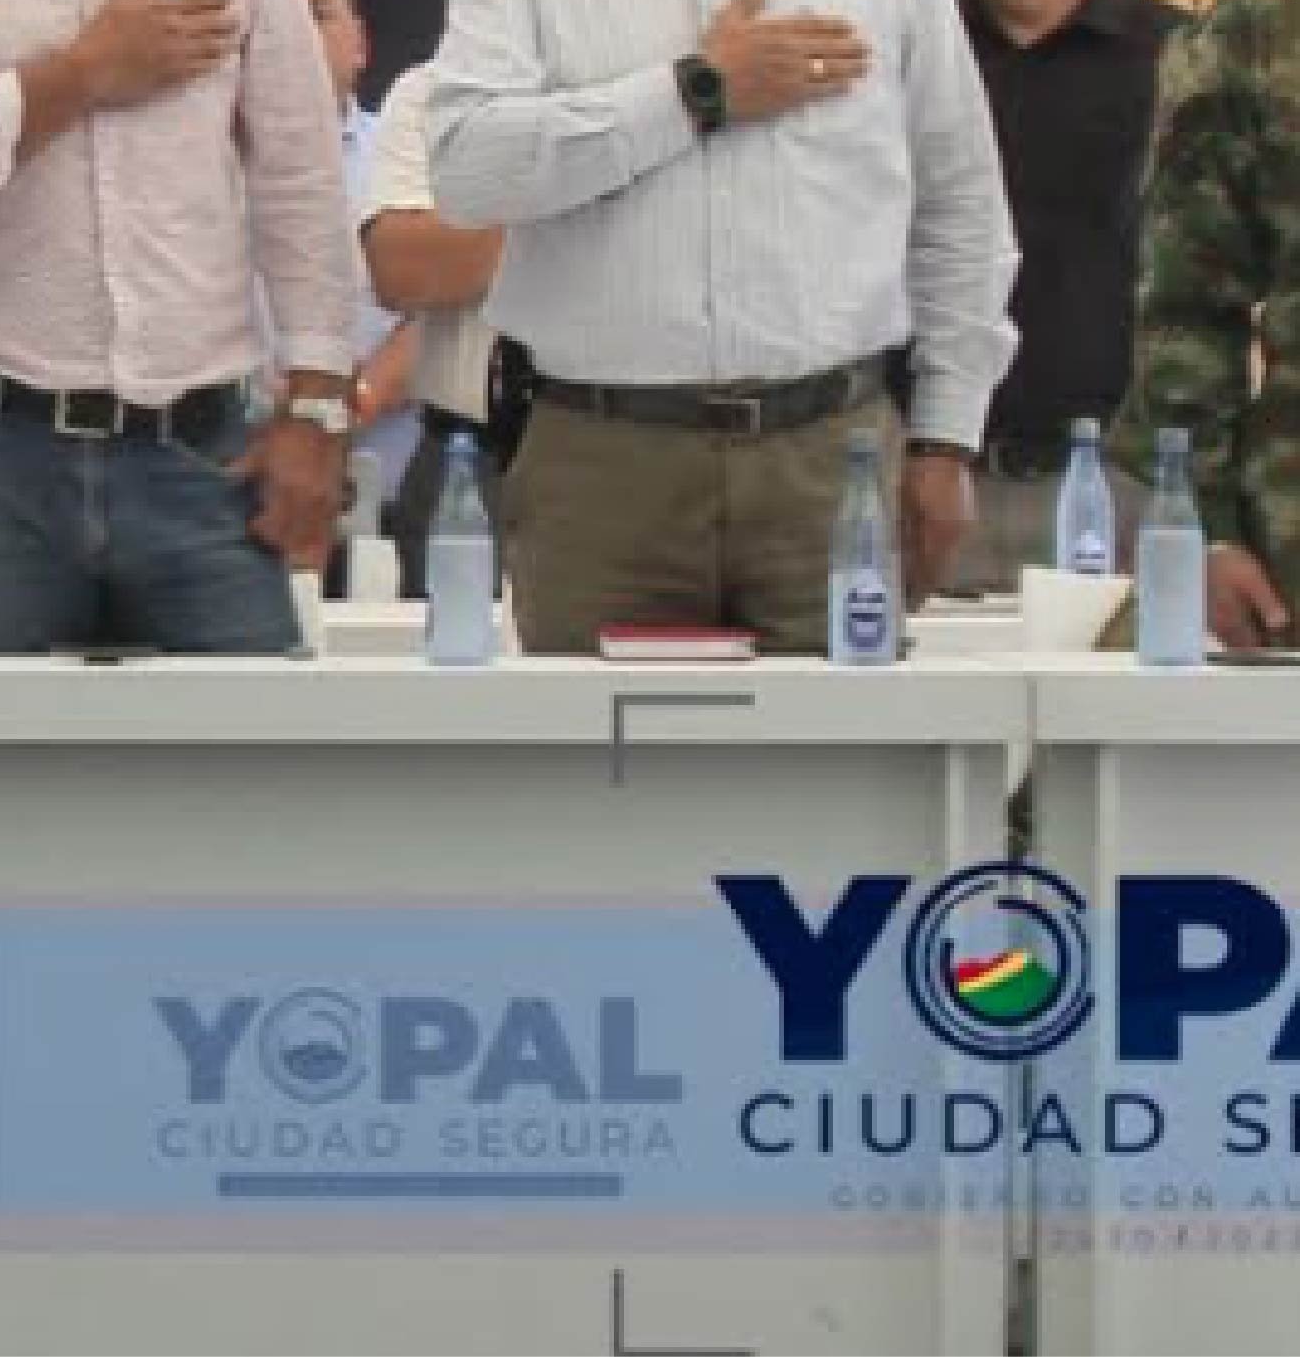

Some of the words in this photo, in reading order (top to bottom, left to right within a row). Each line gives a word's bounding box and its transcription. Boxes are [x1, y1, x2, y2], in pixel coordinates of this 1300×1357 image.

[151, 987, 683, 1104] YOPAL
[156, 1118, 402, 1159] CIUDAD
[439, 1116, 678, 1158] SEGURA
